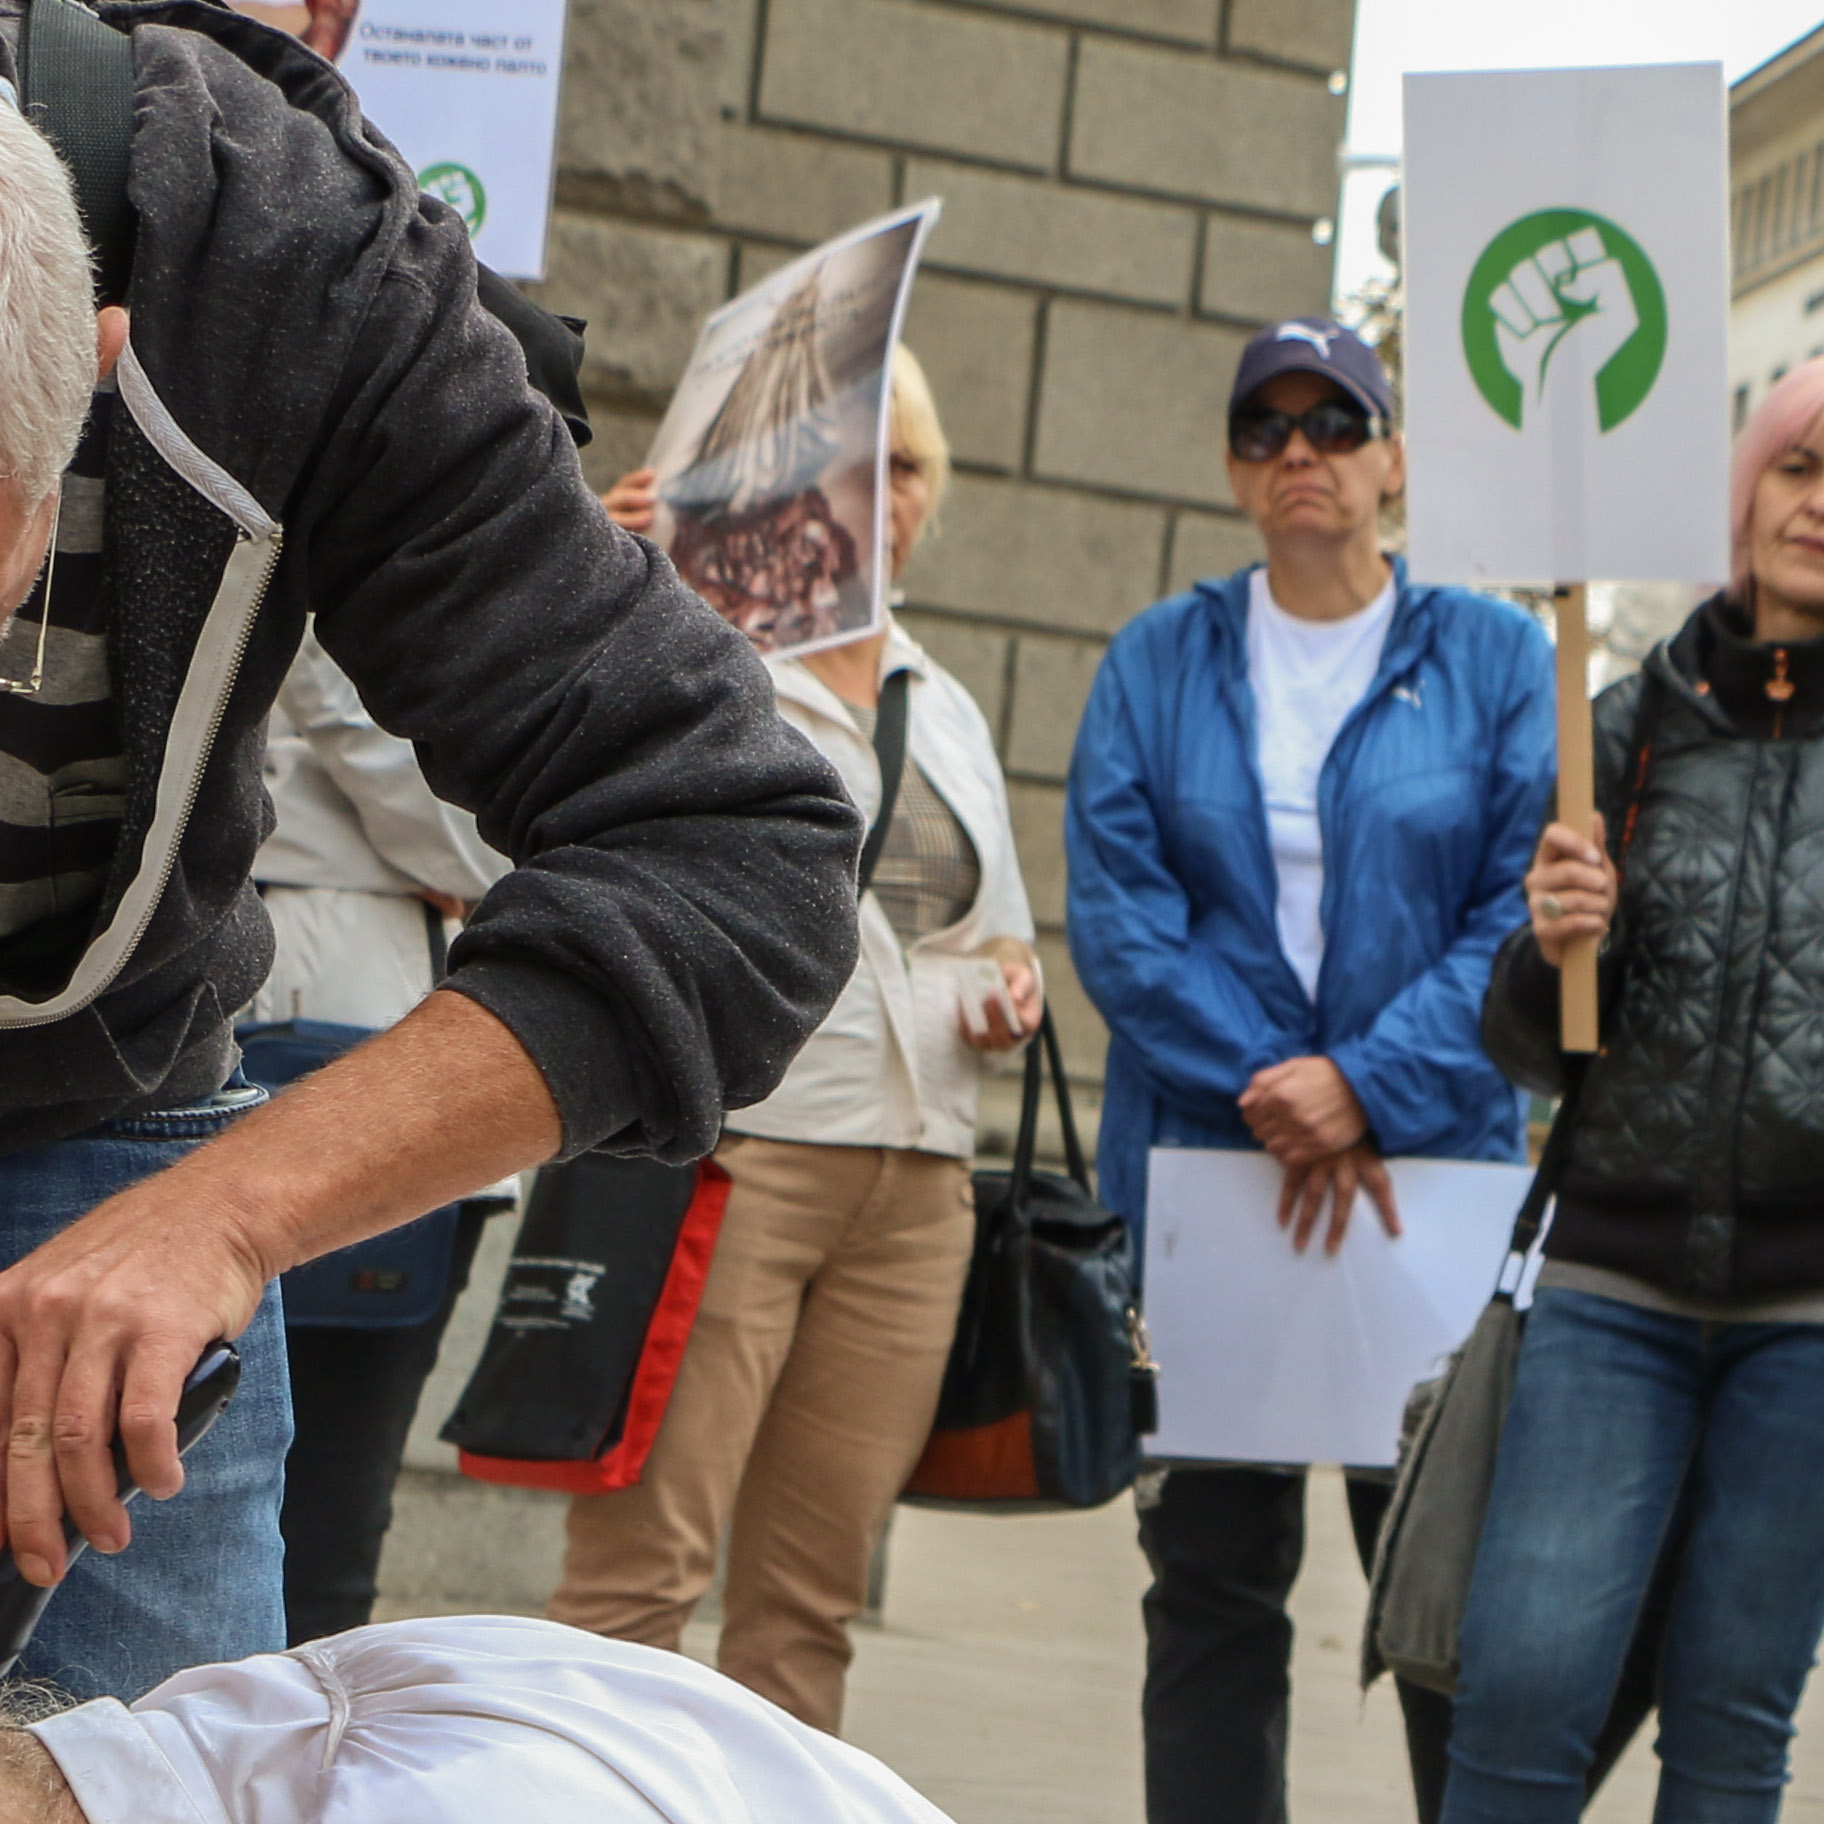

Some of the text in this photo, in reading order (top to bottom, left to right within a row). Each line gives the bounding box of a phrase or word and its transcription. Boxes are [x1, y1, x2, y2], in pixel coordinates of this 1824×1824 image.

[360, 21, 533, 49] Останалата част от
[364, 48, 546, 75] твоето кожено палто
